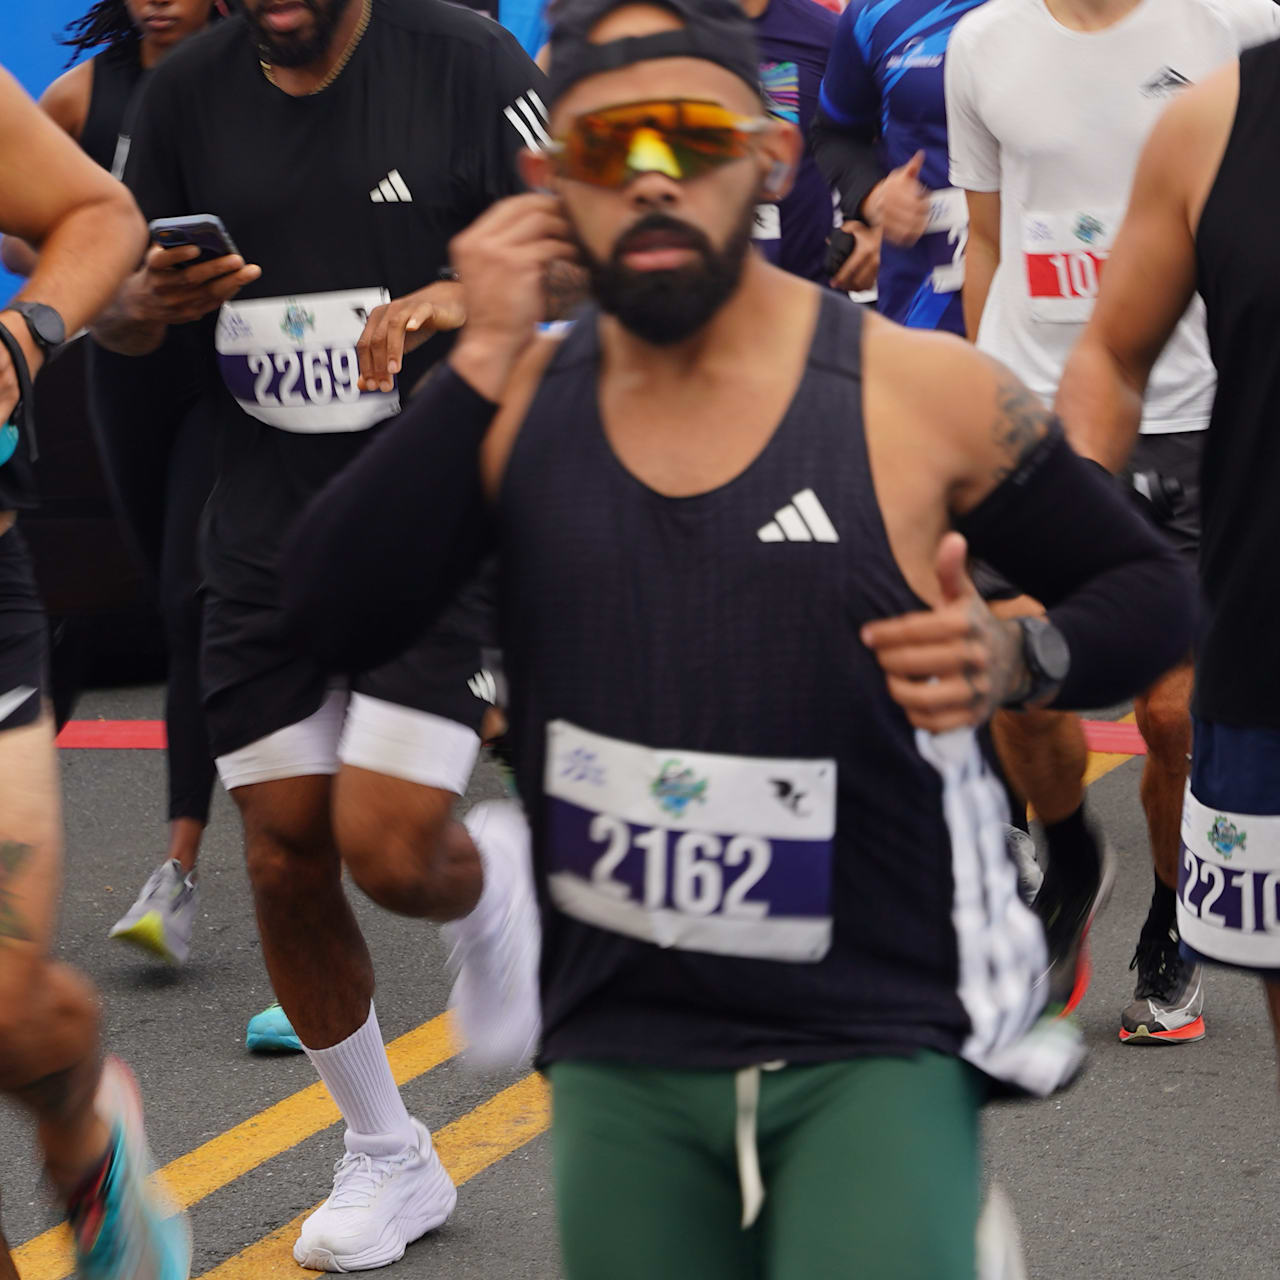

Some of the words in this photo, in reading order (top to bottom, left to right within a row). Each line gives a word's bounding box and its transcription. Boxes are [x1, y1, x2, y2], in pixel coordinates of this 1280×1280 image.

[1047, 250, 1109, 300] 10
[247, 348, 361, 408] 2269
[589, 814, 773, 919] 2162
